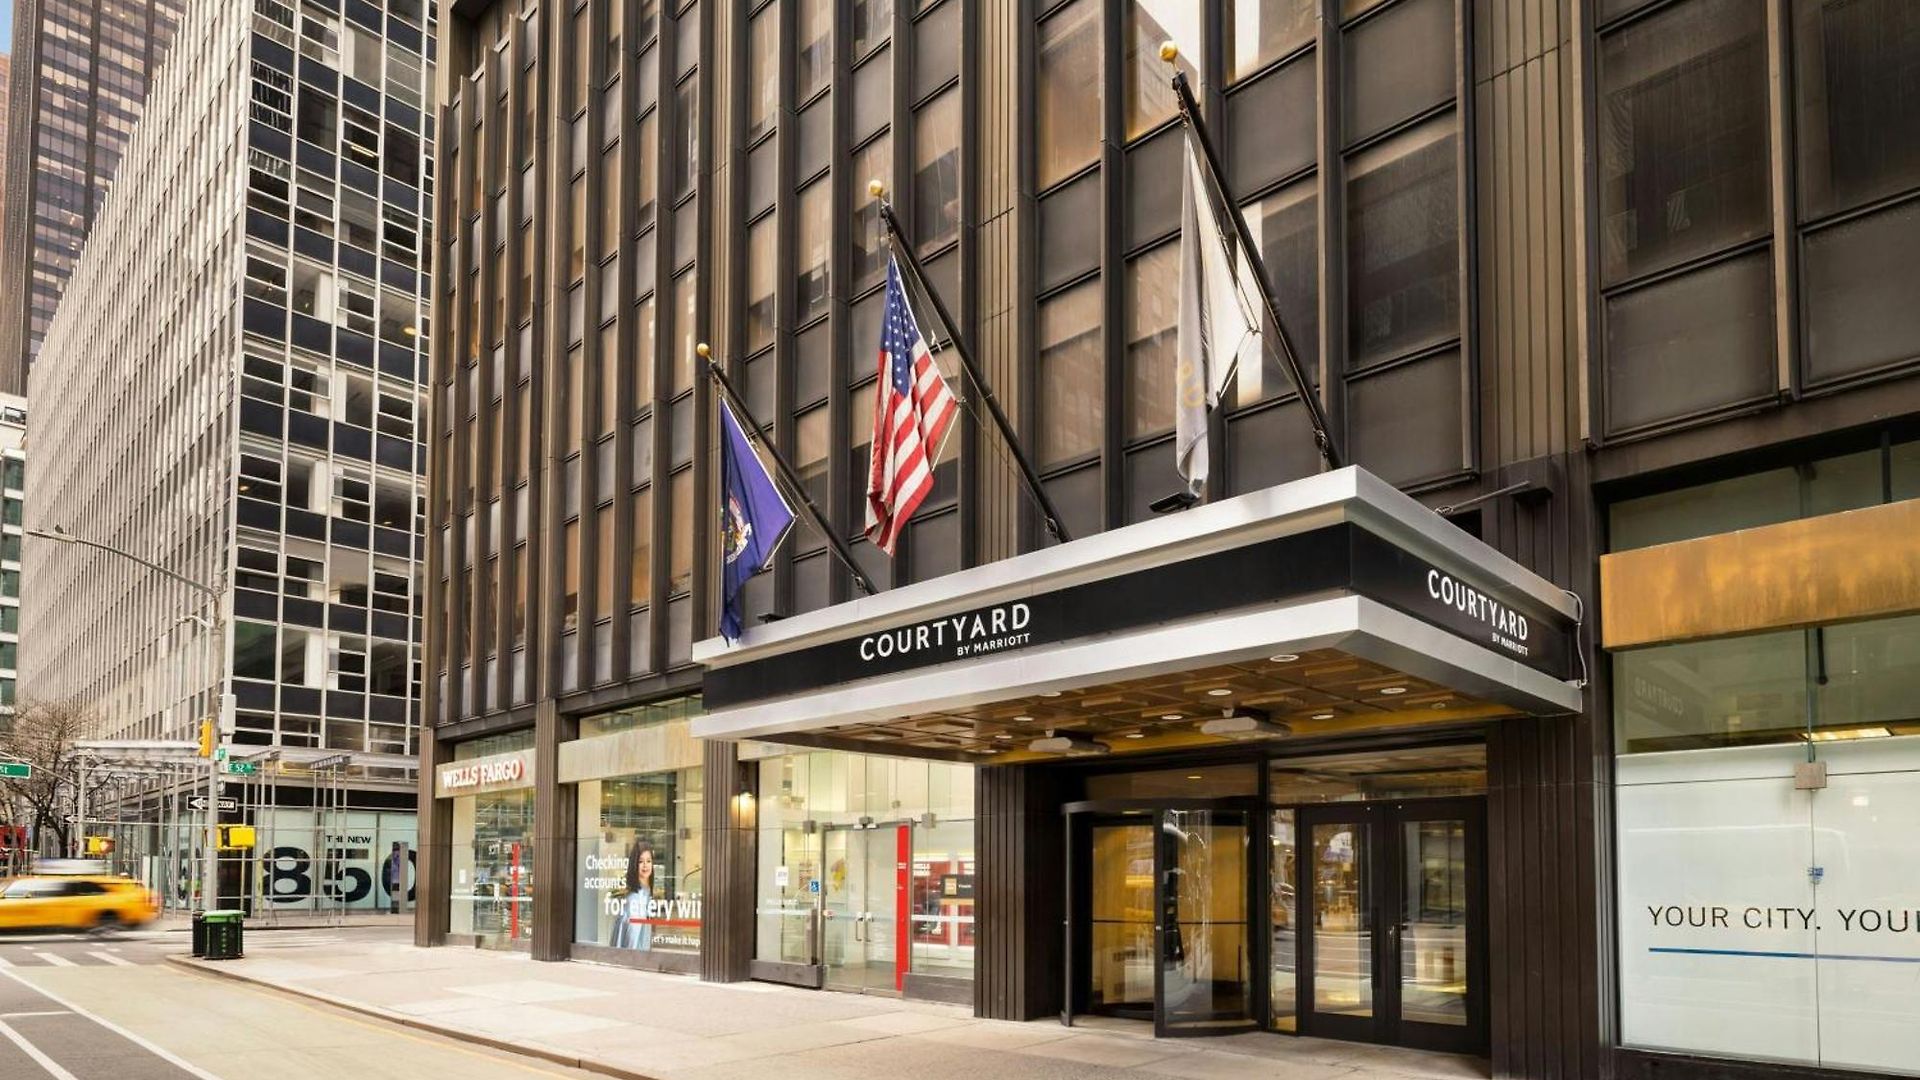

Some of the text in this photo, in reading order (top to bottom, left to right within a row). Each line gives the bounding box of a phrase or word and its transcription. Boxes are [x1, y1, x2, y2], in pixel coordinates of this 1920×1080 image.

[1428, 569, 1528, 641] COURTYARD
[860, 603, 1030, 661] COURTYARD
[957, 633, 1031, 656] BY MARRIOTT
[443, 759, 523, 789] WELLS FARGO
[347, 836, 372, 844] NEW
[262, 847, 418, 903] 850
[585, 854, 630, 873] Checking
[584, 876, 627, 889] accounts
[604, 892, 627, 916] for
[1648, 906, 1729, 928] YOUR
[1743, 907, 1821, 930] CITY.
